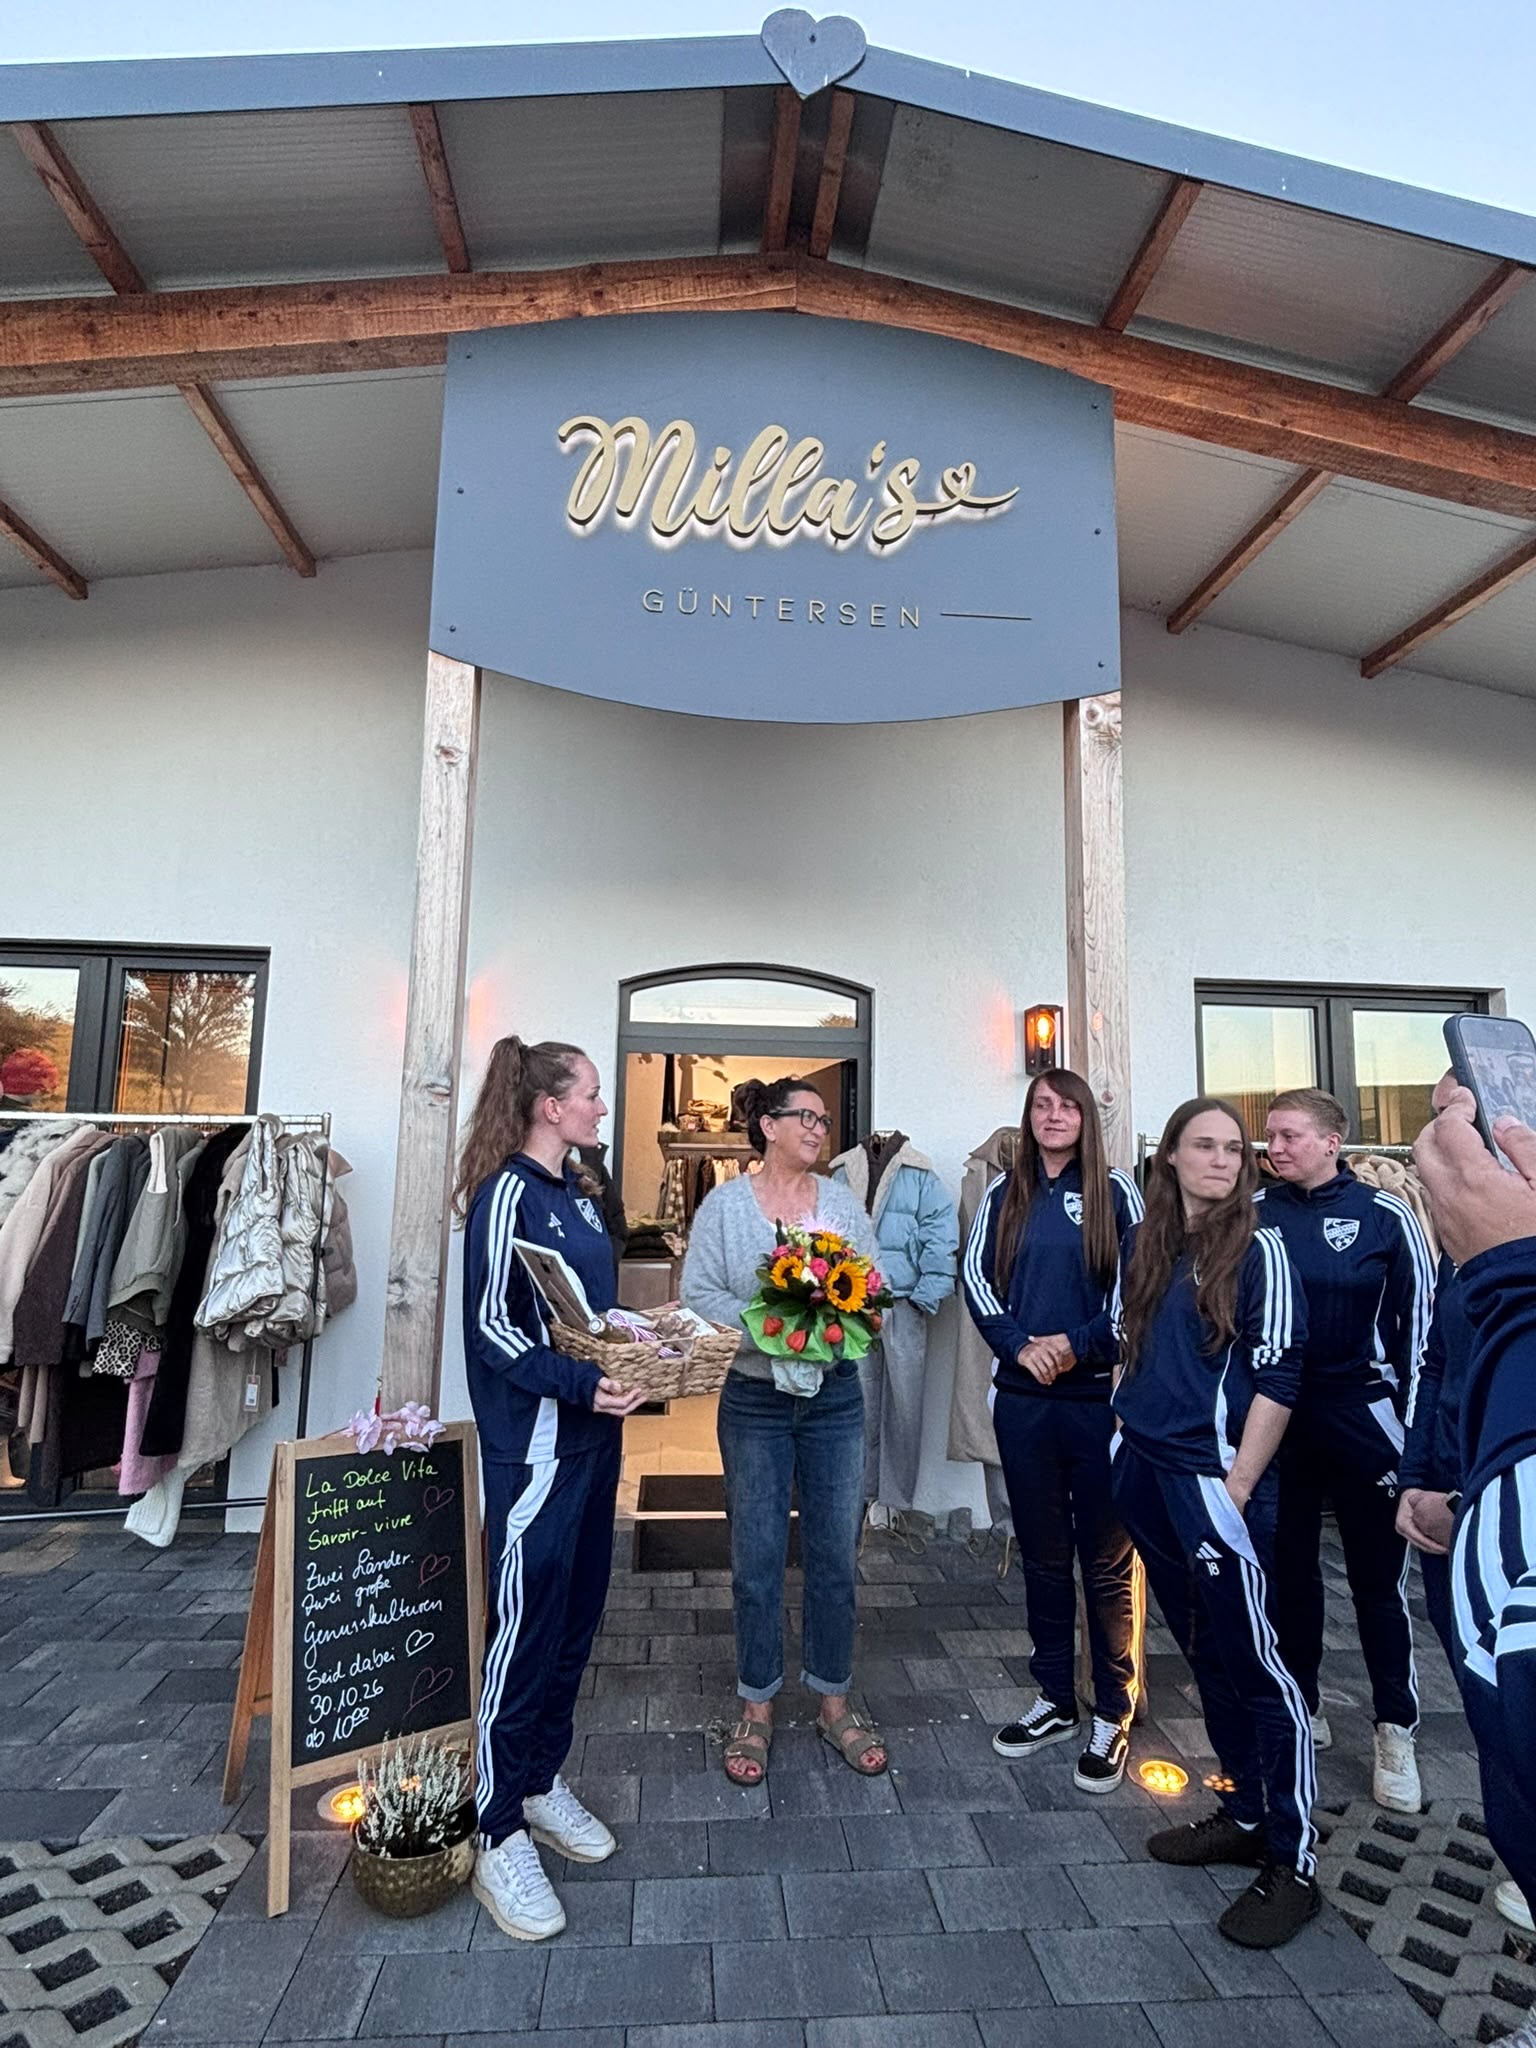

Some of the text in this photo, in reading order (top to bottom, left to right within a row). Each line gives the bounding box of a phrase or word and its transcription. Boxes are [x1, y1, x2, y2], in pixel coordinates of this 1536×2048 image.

[558, 415, 1019, 545] Milla's
[643, 587, 921, 629] GÜNTERSEN
[305, 1456, 438, 1498] La Dolce Vita
[1388, 1486, 1396, 1498] 6
[374, 1514, 414, 1533] vivre
[306, 1562, 343, 1591] Zwei
[1205, 1561, 1220, 1577] 18
[355, 1573, 392, 1608] große
[306, 1647, 396, 1692] Seid dabei
[306, 1728, 326, 1749] ab
